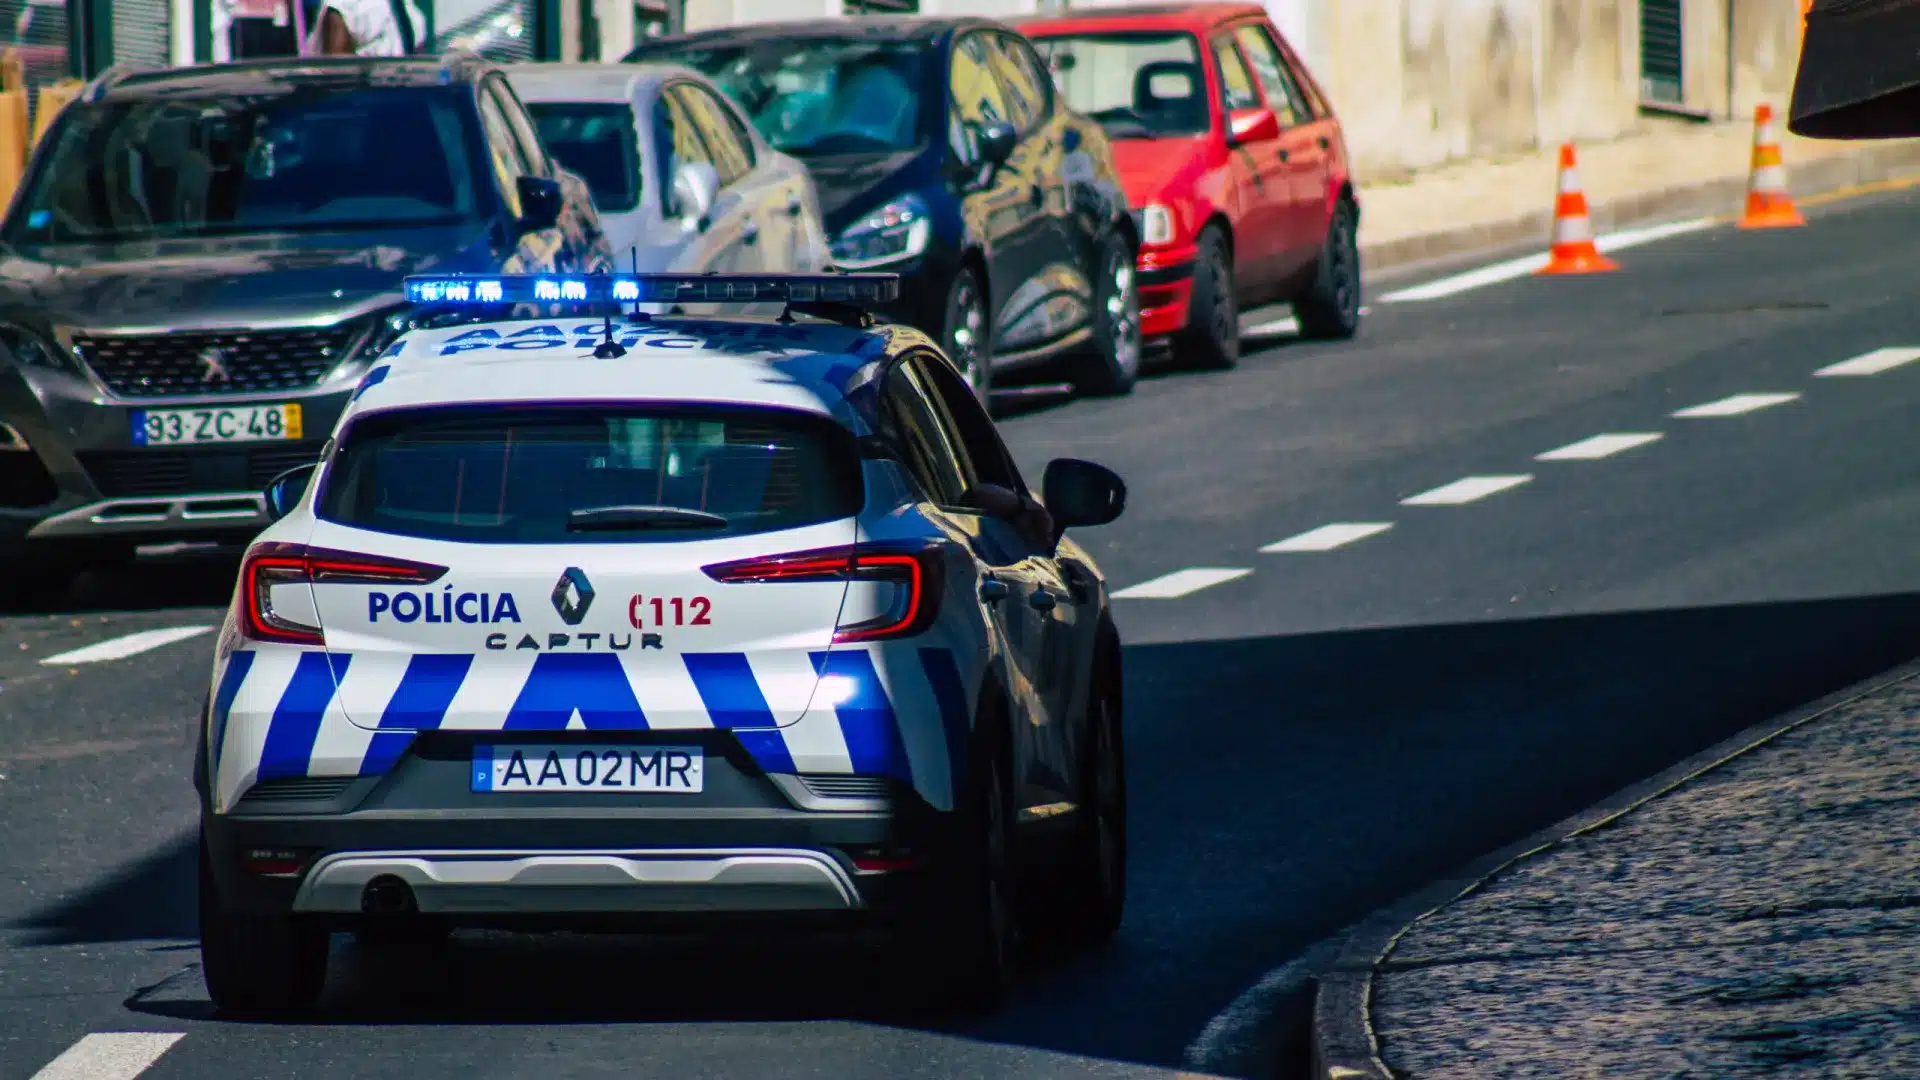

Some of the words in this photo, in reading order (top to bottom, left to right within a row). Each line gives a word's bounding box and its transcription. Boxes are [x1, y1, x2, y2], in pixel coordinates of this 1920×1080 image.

[368, 583, 521, 623] POLÍCIA
[649, 596, 711, 626] 112
[485, 633, 664, 650] CAPTUR
